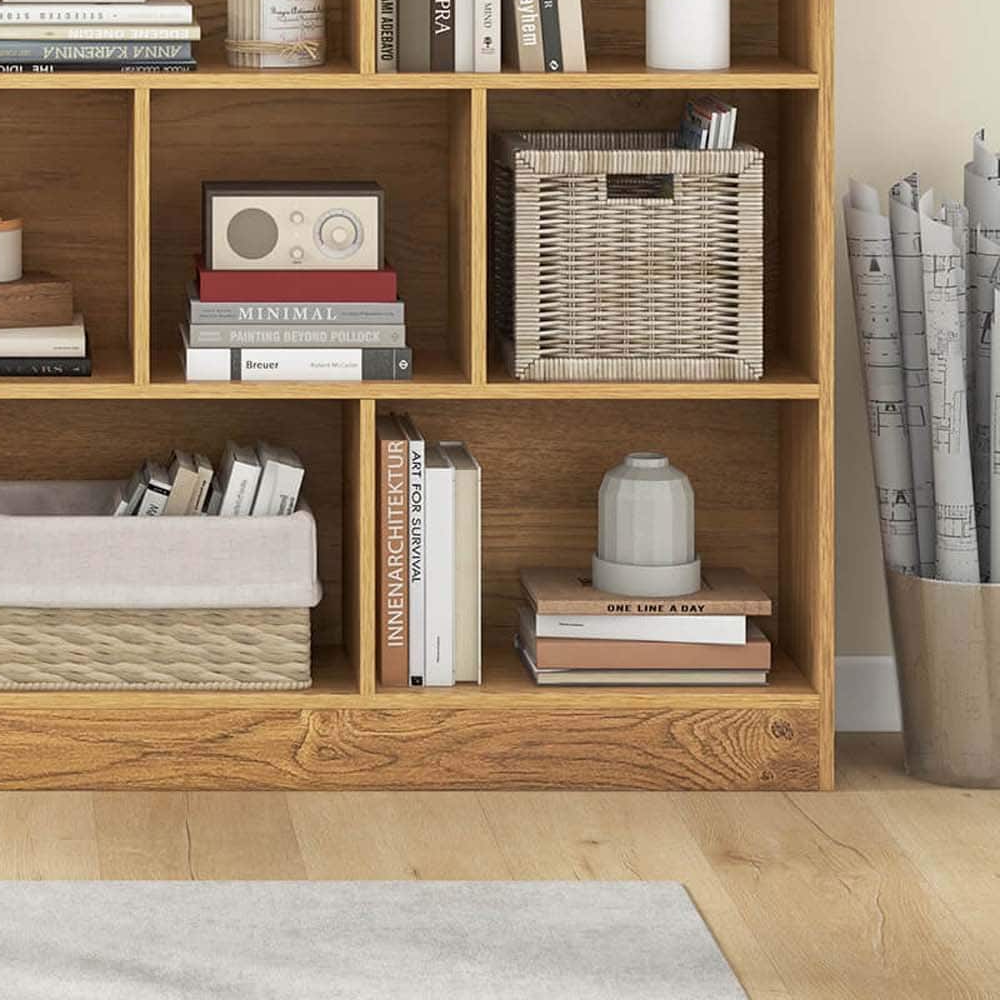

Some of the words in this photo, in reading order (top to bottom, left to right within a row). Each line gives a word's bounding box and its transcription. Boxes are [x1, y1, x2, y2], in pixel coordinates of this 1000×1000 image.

[381, 17, 393, 61] ADEBAYO
[43, 45, 129, 60] KARENINA
[131, 45, 182, 59] ANNA
[238, 307, 337, 321] MINIMAL
[230, 331, 281, 342] PAINTING
[284, 331, 328, 342] BEYOND
[330, 331, 380, 342] POLLOCK
[245, 360, 279, 370] Breuer
[411, 450, 423, 478] ART
[411, 483, 422, 512] FOR
[388, 440, 404, 647] INNENARCHITEKTUR
[411, 518, 423, 584] SURVIVAL
[607, 604, 632, 613] ONE
[637, 604, 664, 613] LINE
[669, 604, 677, 613] A
[681, 604, 706, 613] DAY
